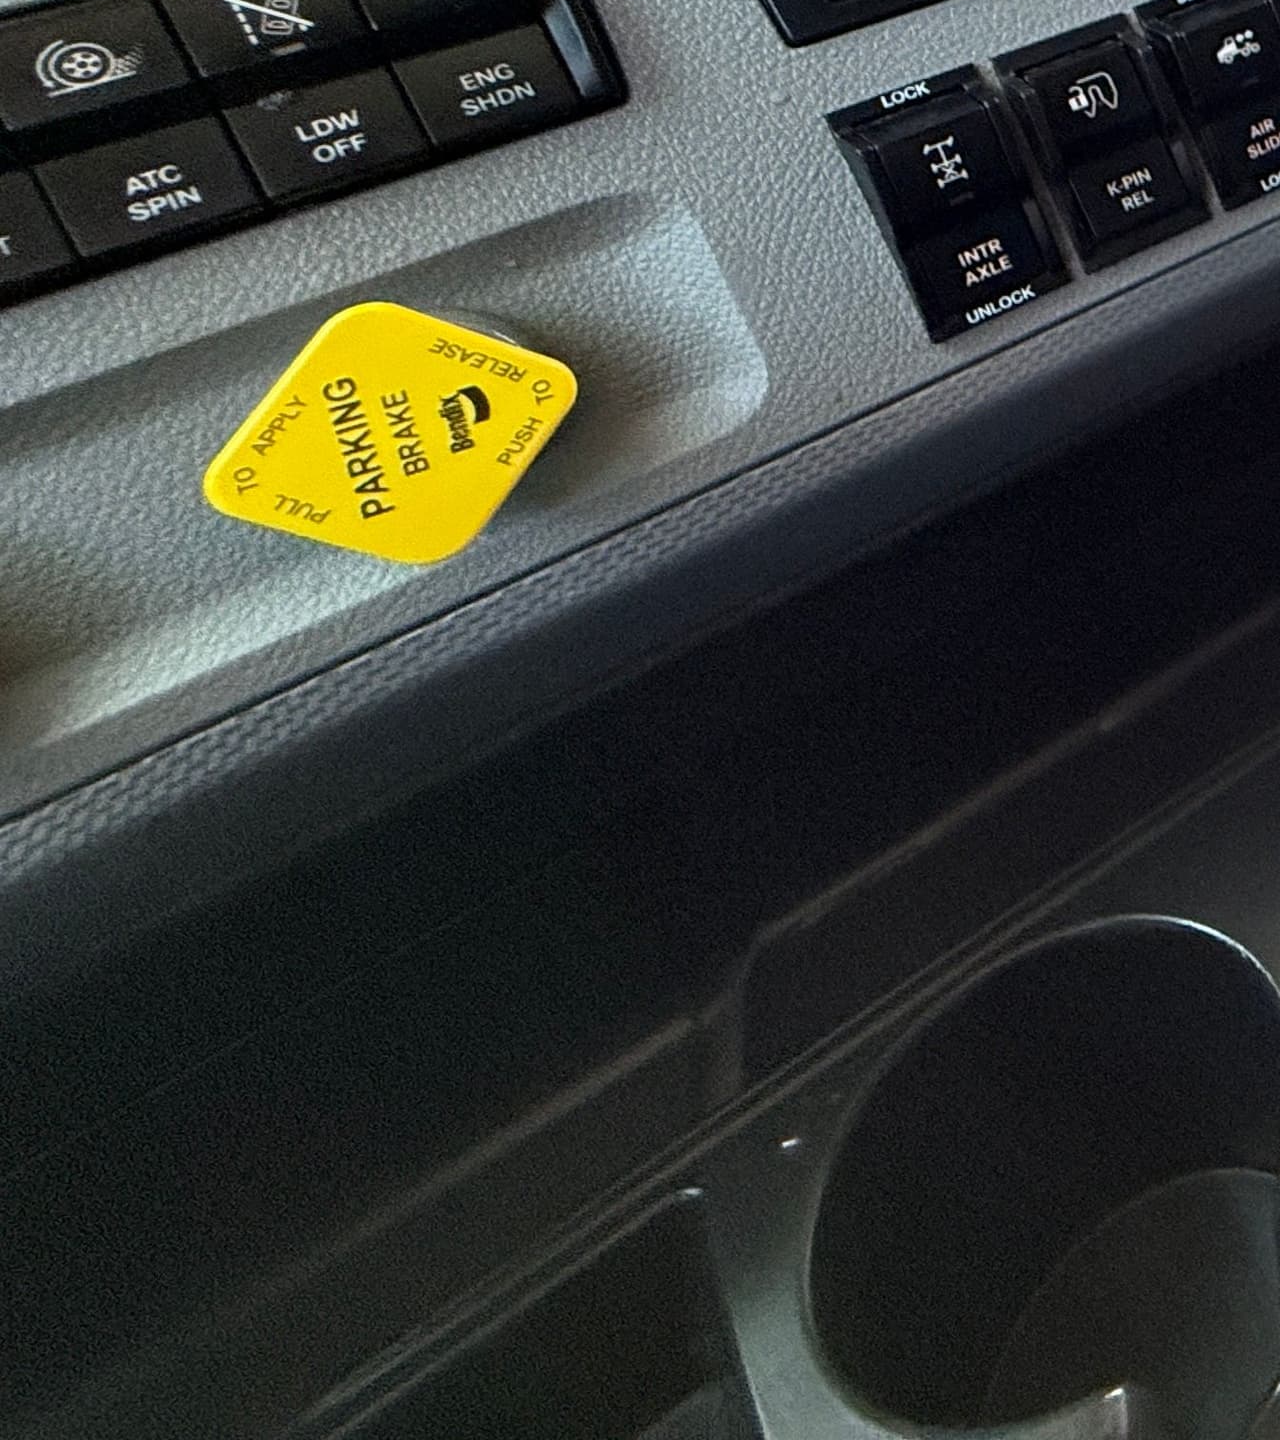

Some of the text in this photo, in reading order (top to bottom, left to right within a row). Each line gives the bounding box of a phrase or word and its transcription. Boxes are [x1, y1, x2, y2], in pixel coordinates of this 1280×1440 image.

[458, 62, 515, 92] ENG
[460, 81, 537, 117] SHDN
[880, 81, 931, 109] LOCK
[295, 109, 361, 143] LDW
[1250, 117, 1277, 140] AIR
[312, 132, 367, 164] OFF
[126, 164, 182, 196] ATC
[1106, 167, 1153, 197] K-PIN
[127, 185, 203, 222] SPIN
[1121, 190, 1154, 212] REL
[957, 238, 1003, 268] INTR
[965, 255, 1014, 287] AXLE
[965, 284, 1037, 325] UNLOCK
[428, 337, 554, 466] PUSH TO RELEASE
[381, 389, 430, 477] BRAKE
[438, 396, 475, 455] Bendix
[233, 395, 332, 525] PULL TO APPLY
[322, 376, 396, 520] PARKING
